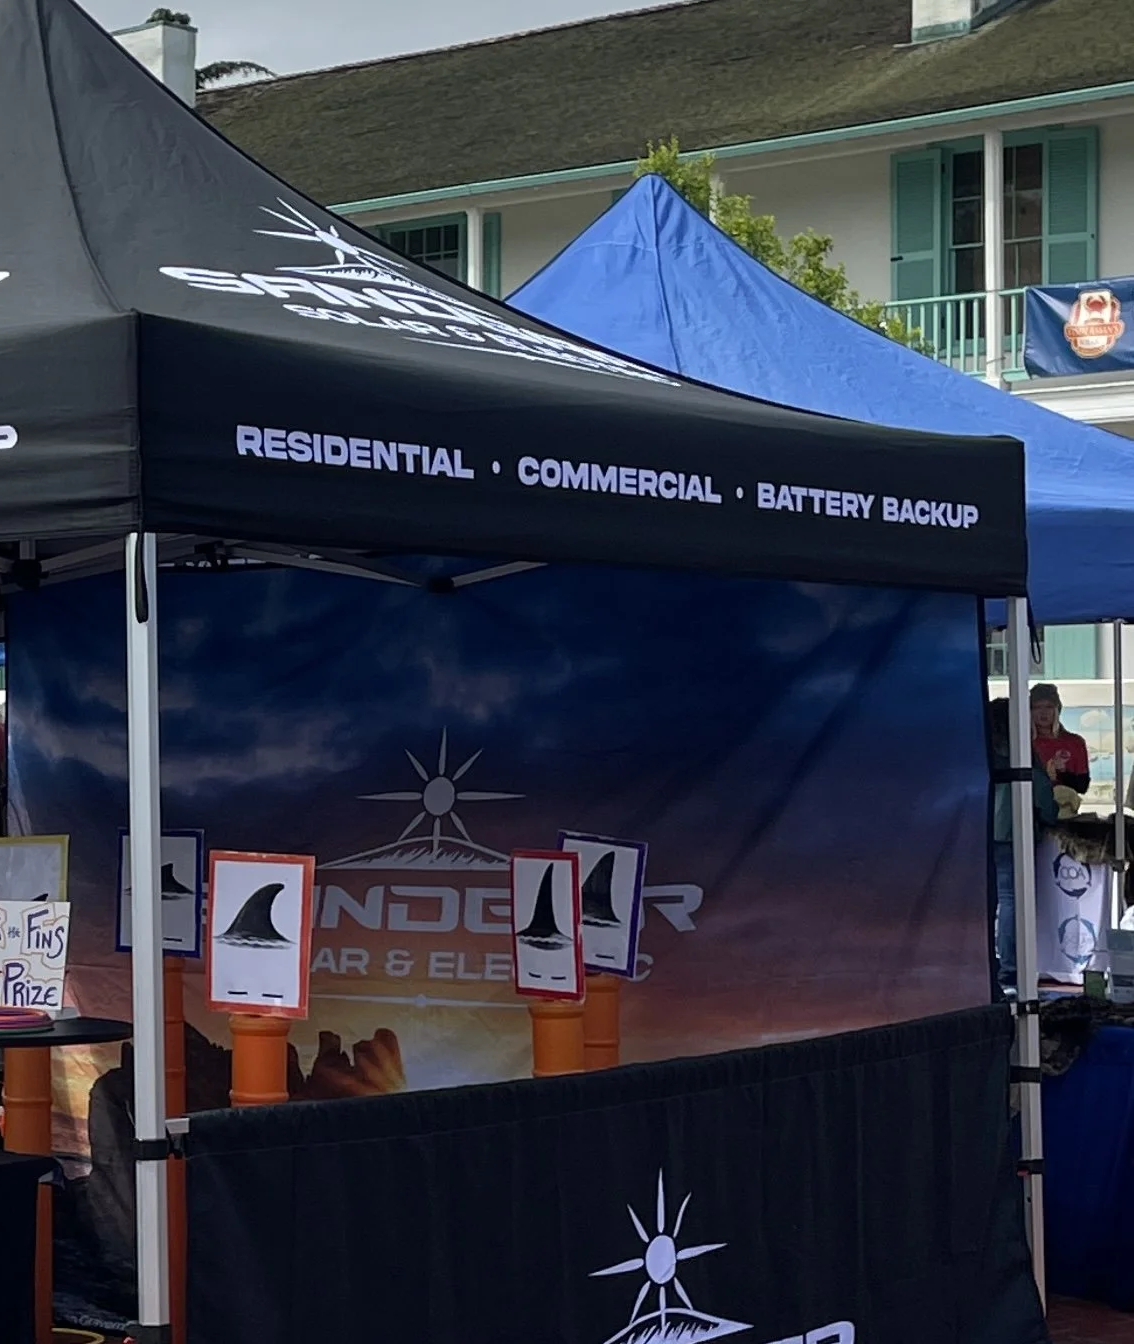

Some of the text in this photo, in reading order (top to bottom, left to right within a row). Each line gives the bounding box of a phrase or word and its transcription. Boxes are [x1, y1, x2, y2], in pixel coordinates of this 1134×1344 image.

[282, 304, 451, 339] SOLAR
[236, 425, 979, 529] RESIDENTIAL COMMERCIAL BATTERY BACKUP
[27, 908, 66, 960] FINS
[385, 949, 414, 977] &
